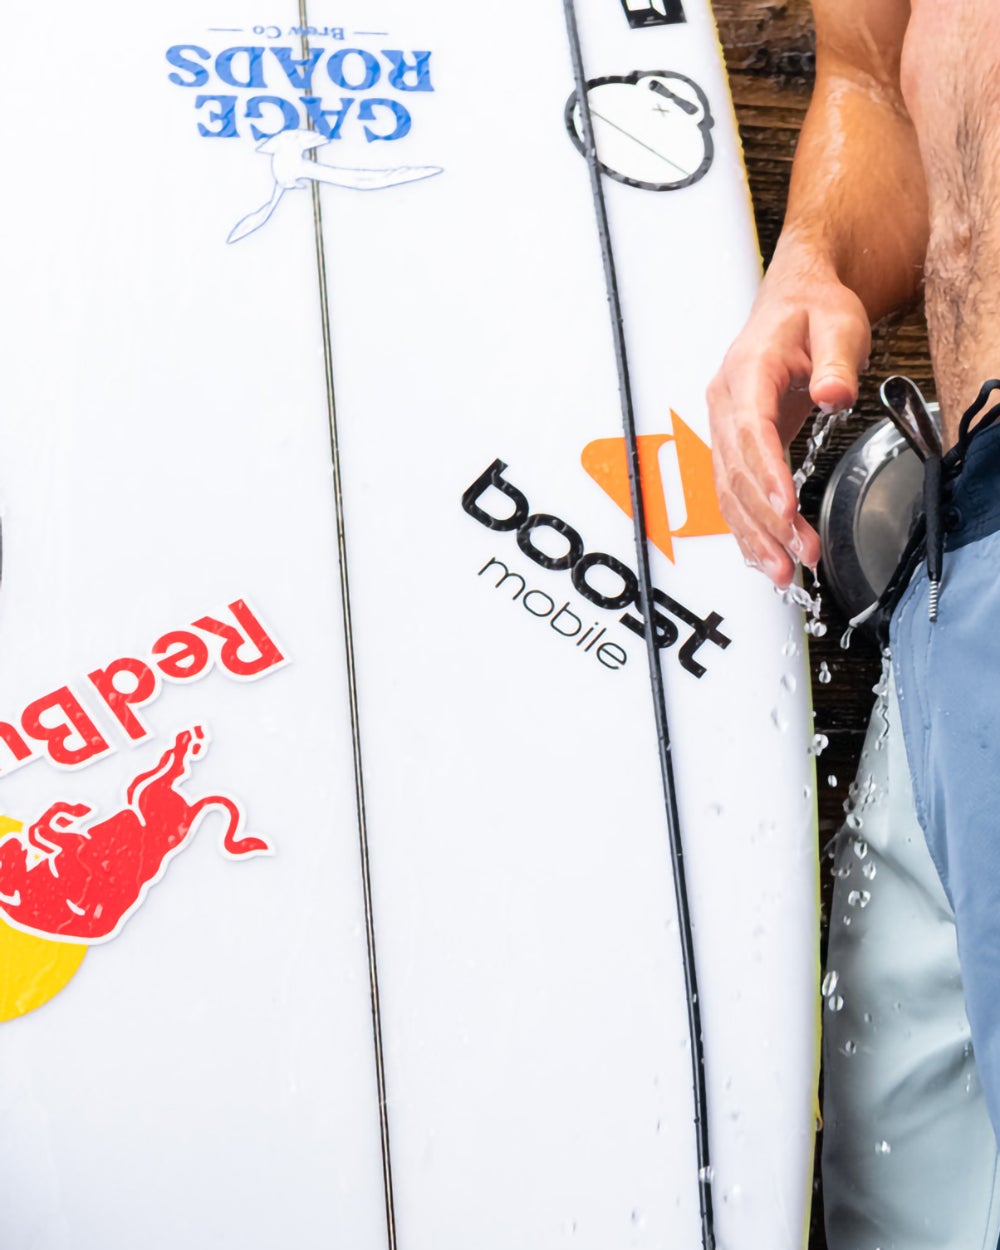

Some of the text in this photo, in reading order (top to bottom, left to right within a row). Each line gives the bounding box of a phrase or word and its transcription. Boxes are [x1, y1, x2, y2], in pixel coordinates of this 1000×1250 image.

[165, 44, 435, 92] ROADS
[288, 26, 345, 41] Brew
[194, 95, 412, 143] GAGE
[461, 458, 732, 679] boost
[477, 556, 627, 670] mobile
[87, 598, 285, 740] Red
